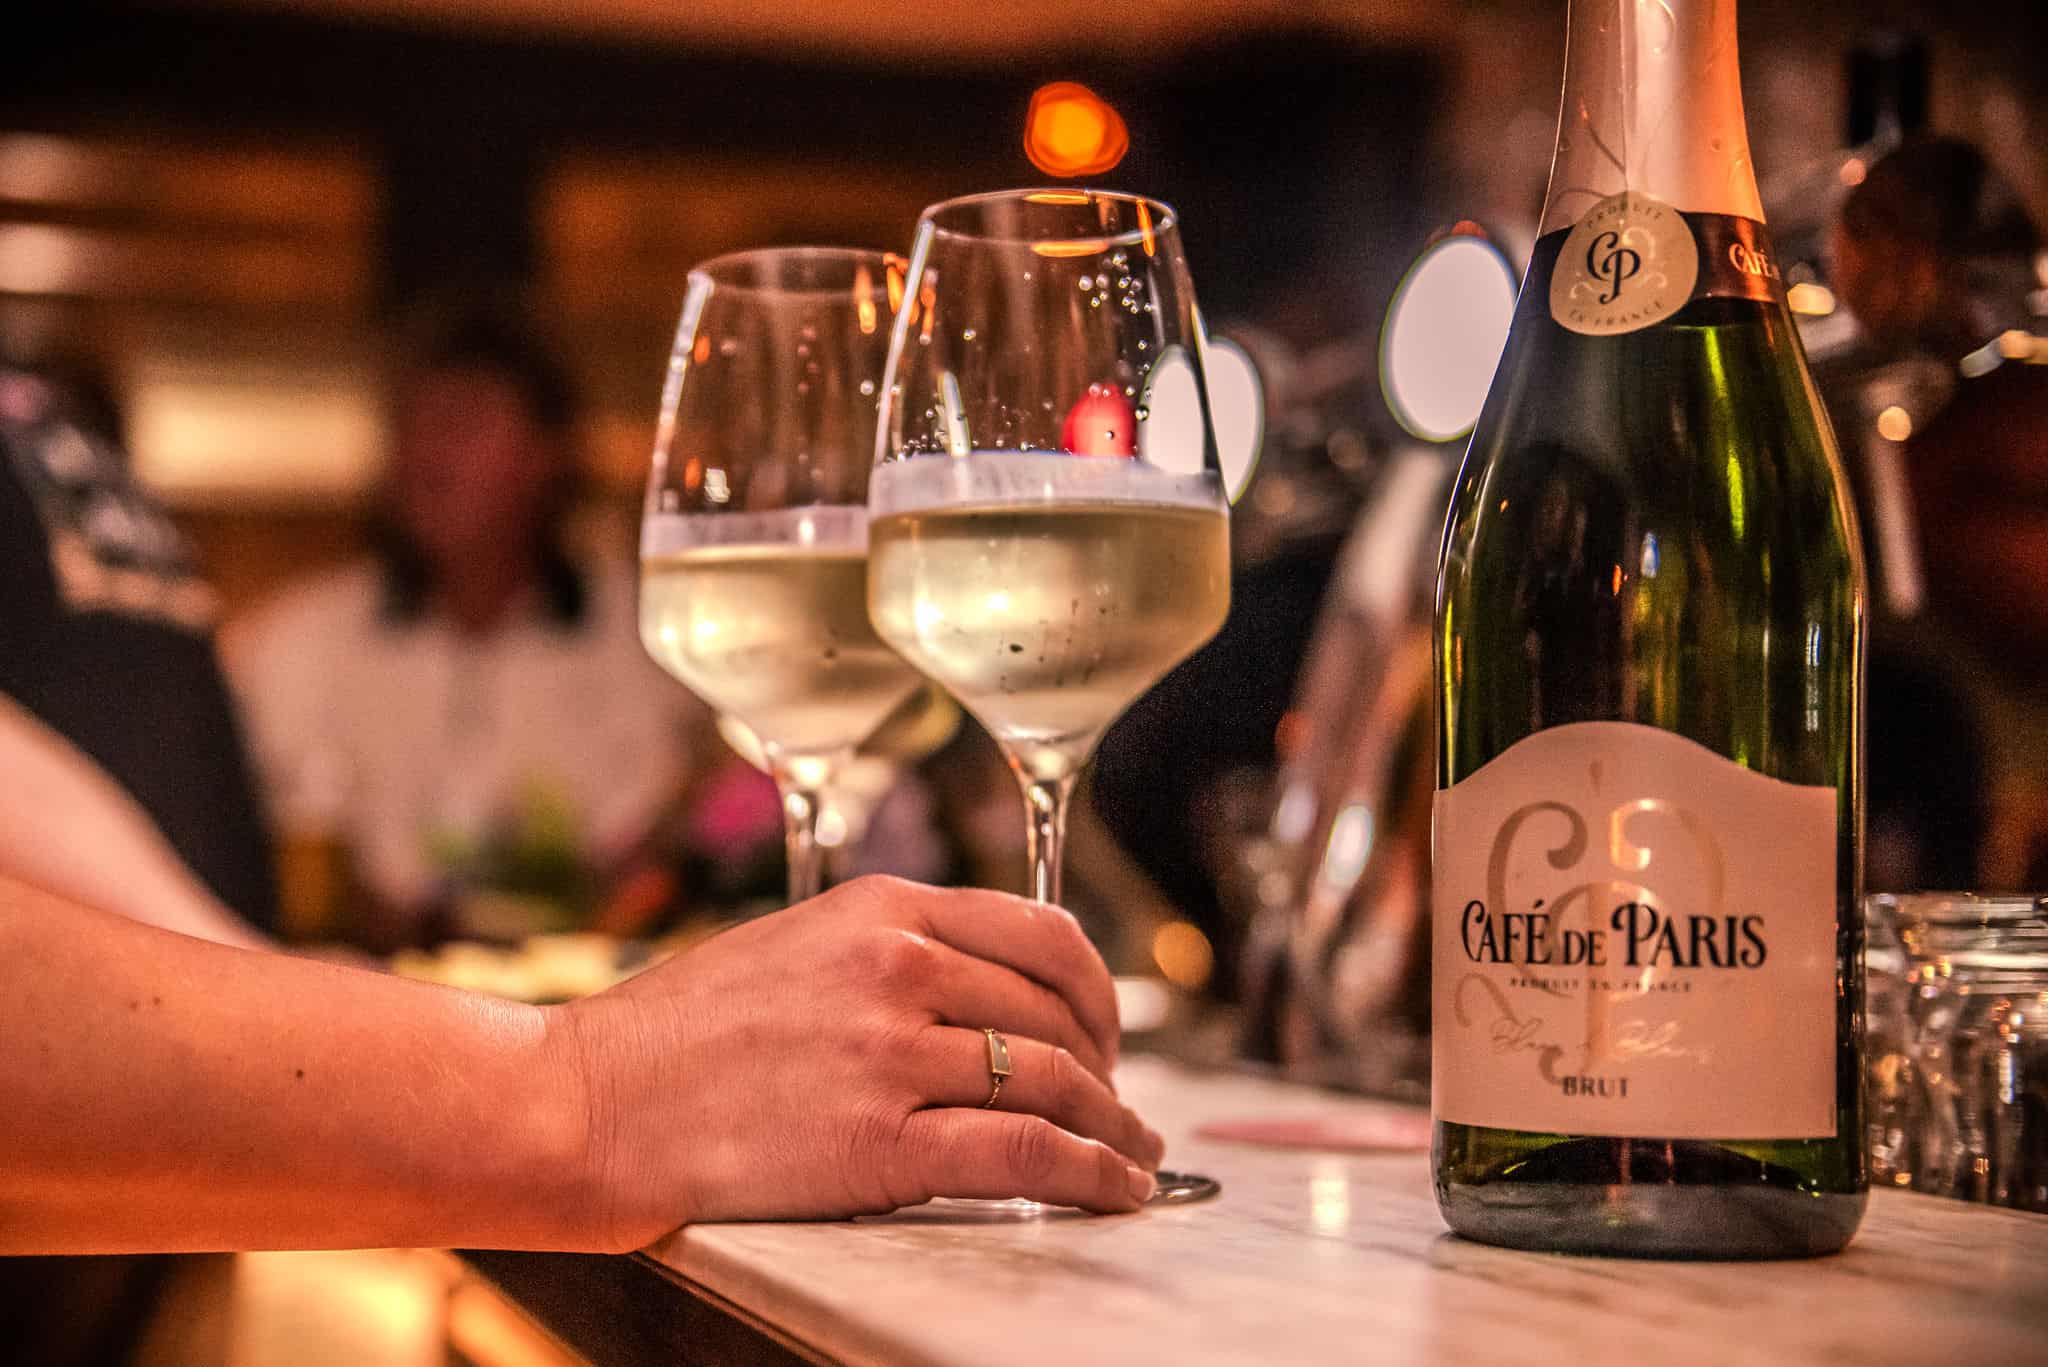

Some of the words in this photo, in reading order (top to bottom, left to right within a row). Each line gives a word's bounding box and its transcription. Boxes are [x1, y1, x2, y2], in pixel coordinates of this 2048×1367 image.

[1461, 899, 1553, 965] CAFÉ
[1562, 929, 1608, 967] DE
[1611, 902, 1768, 969] PARIS
[1561, 1075, 1629, 1098] BRUT
